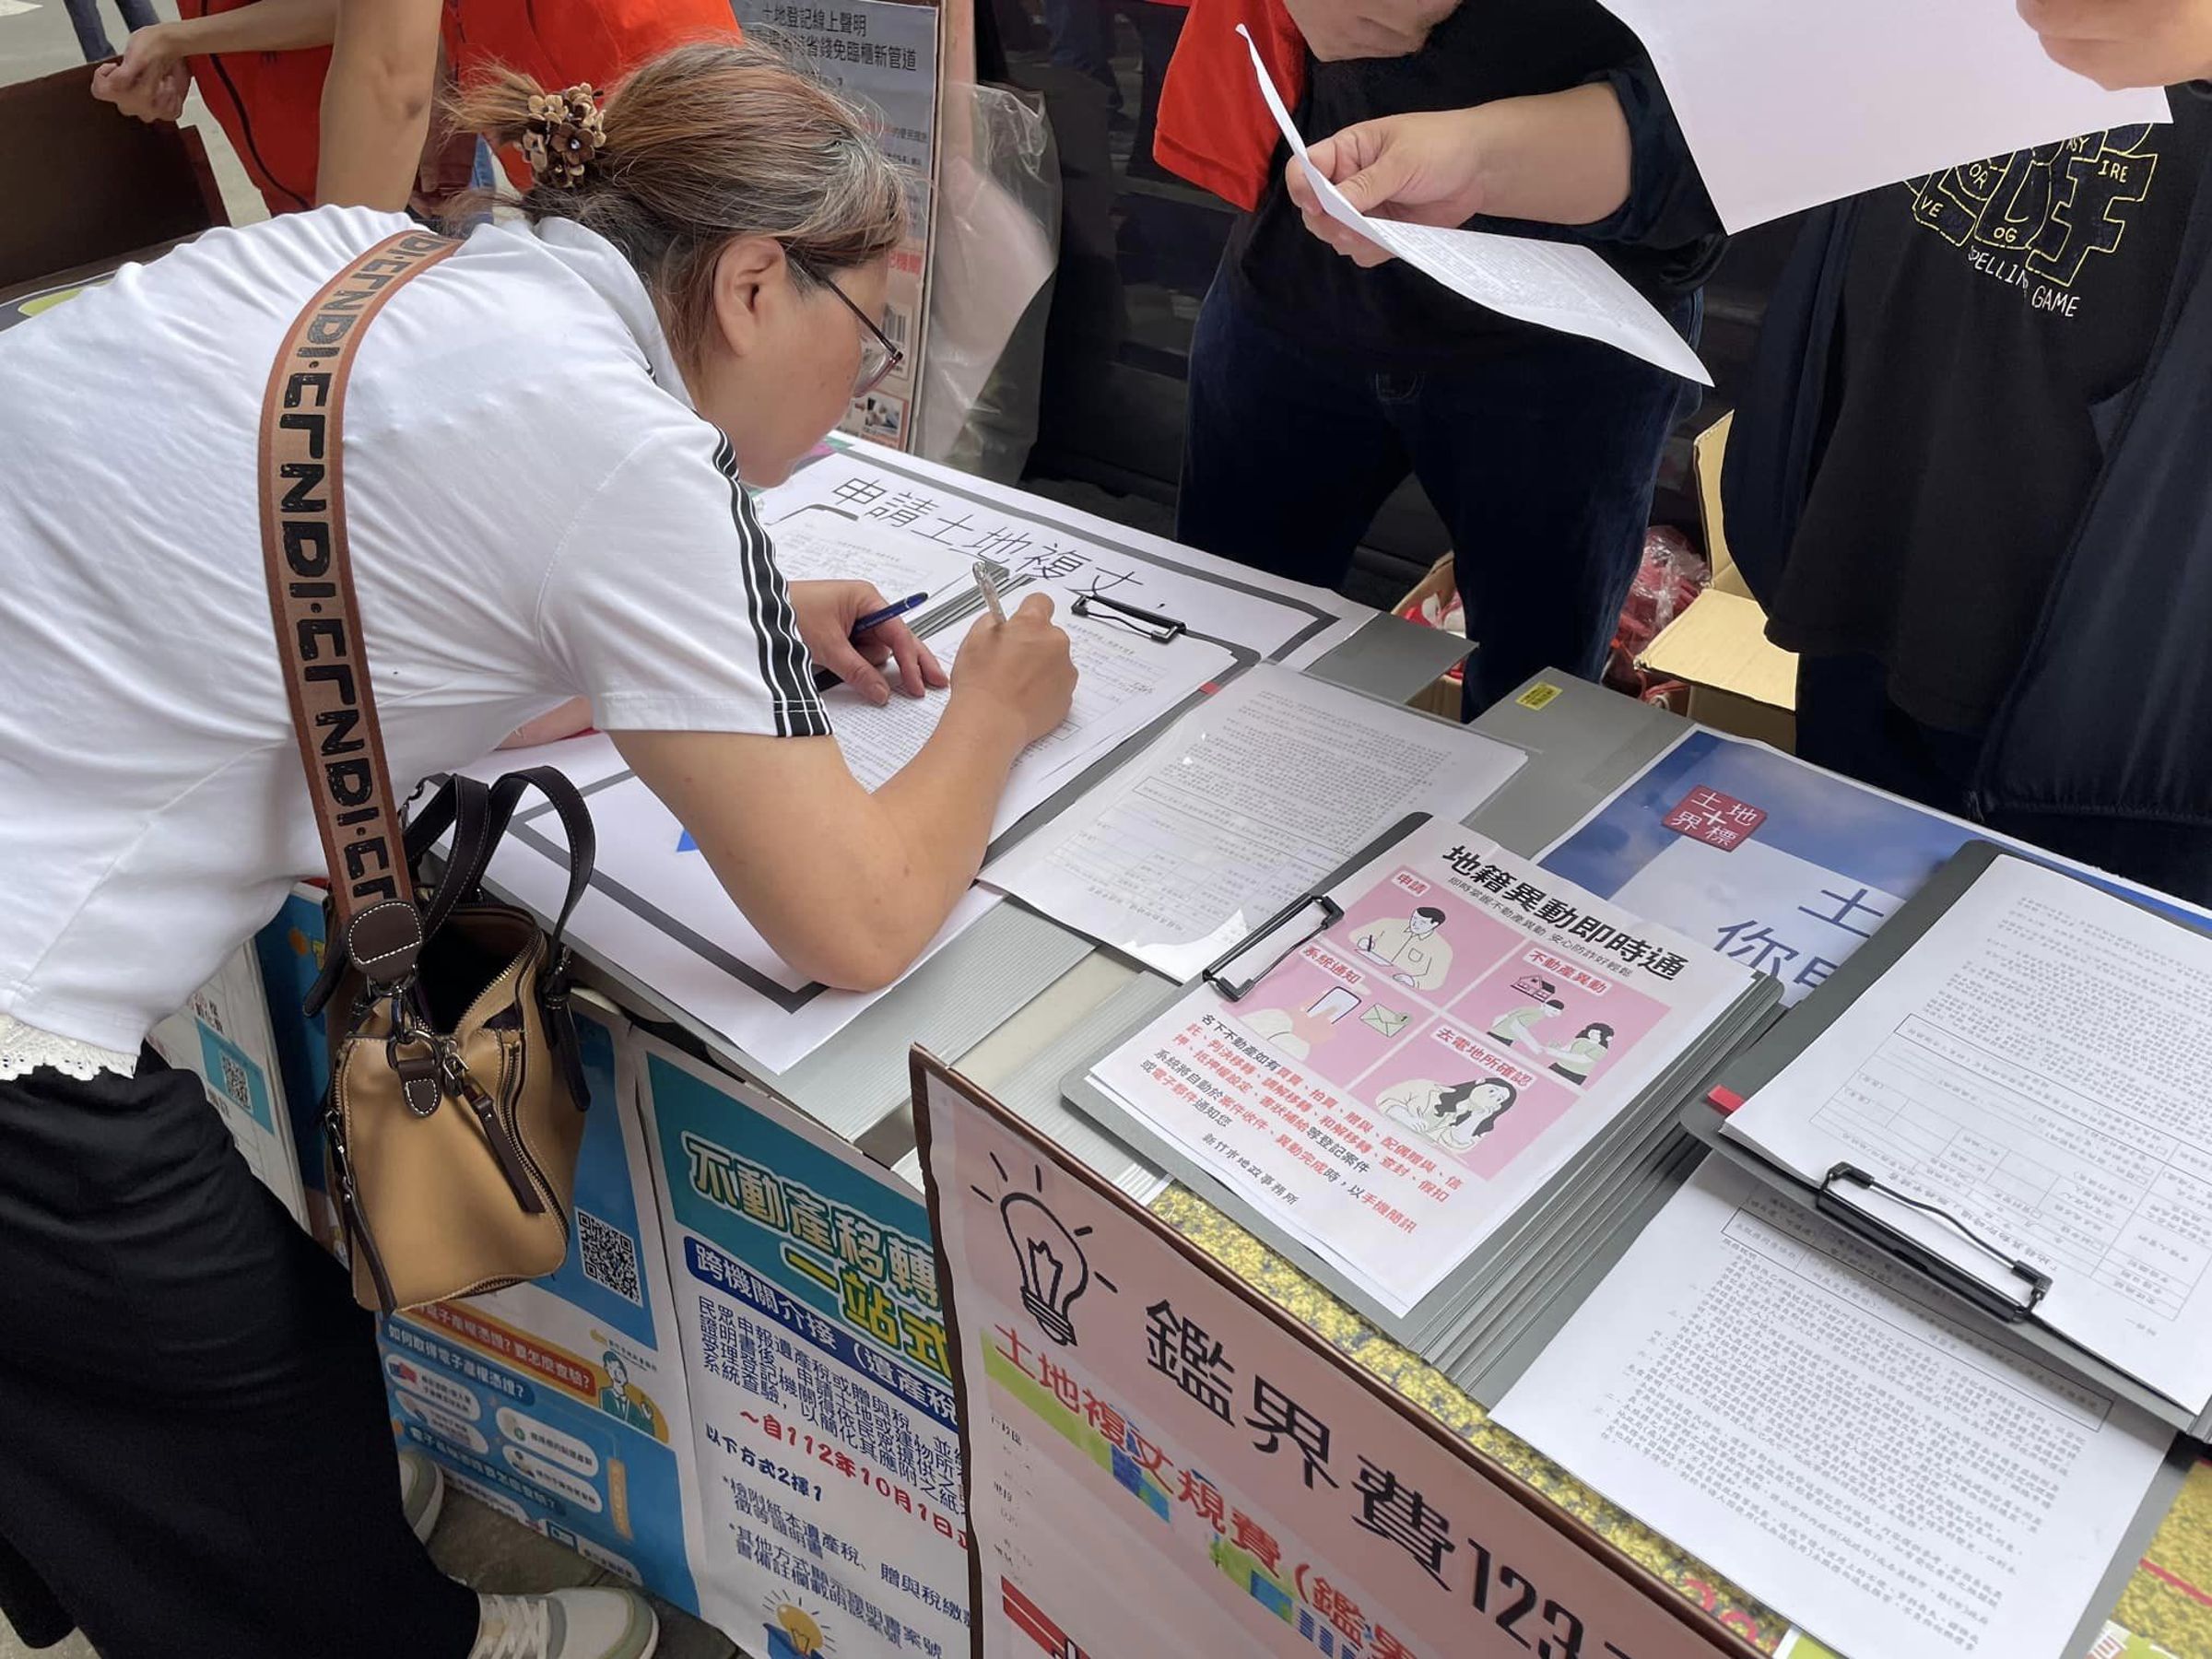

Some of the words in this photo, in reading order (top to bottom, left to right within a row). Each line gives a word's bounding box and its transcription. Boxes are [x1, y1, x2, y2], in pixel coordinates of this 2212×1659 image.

[2031, 285, 2081, 317] GAME
[1395, 872, 1427, 895] 申請
[1442, 844, 1689, 982] 地籍異動即時通
[1448, 877, 1547, 936] 即時掌握不動產異動
[1302, 945, 1361, 985] 系統通知
[1529, 949, 1607, 994] 不動產異動
[1436, 1026, 1535, 1088] 去電地所確認
[1202, 1133, 1300, 1206] 新竹市地政事務所
[685, 1136, 941, 1309] 不動產移轉
[784, 1245, 953, 1381] 一站式
[706, 1422, 823, 1502] 以下方式2擇1
